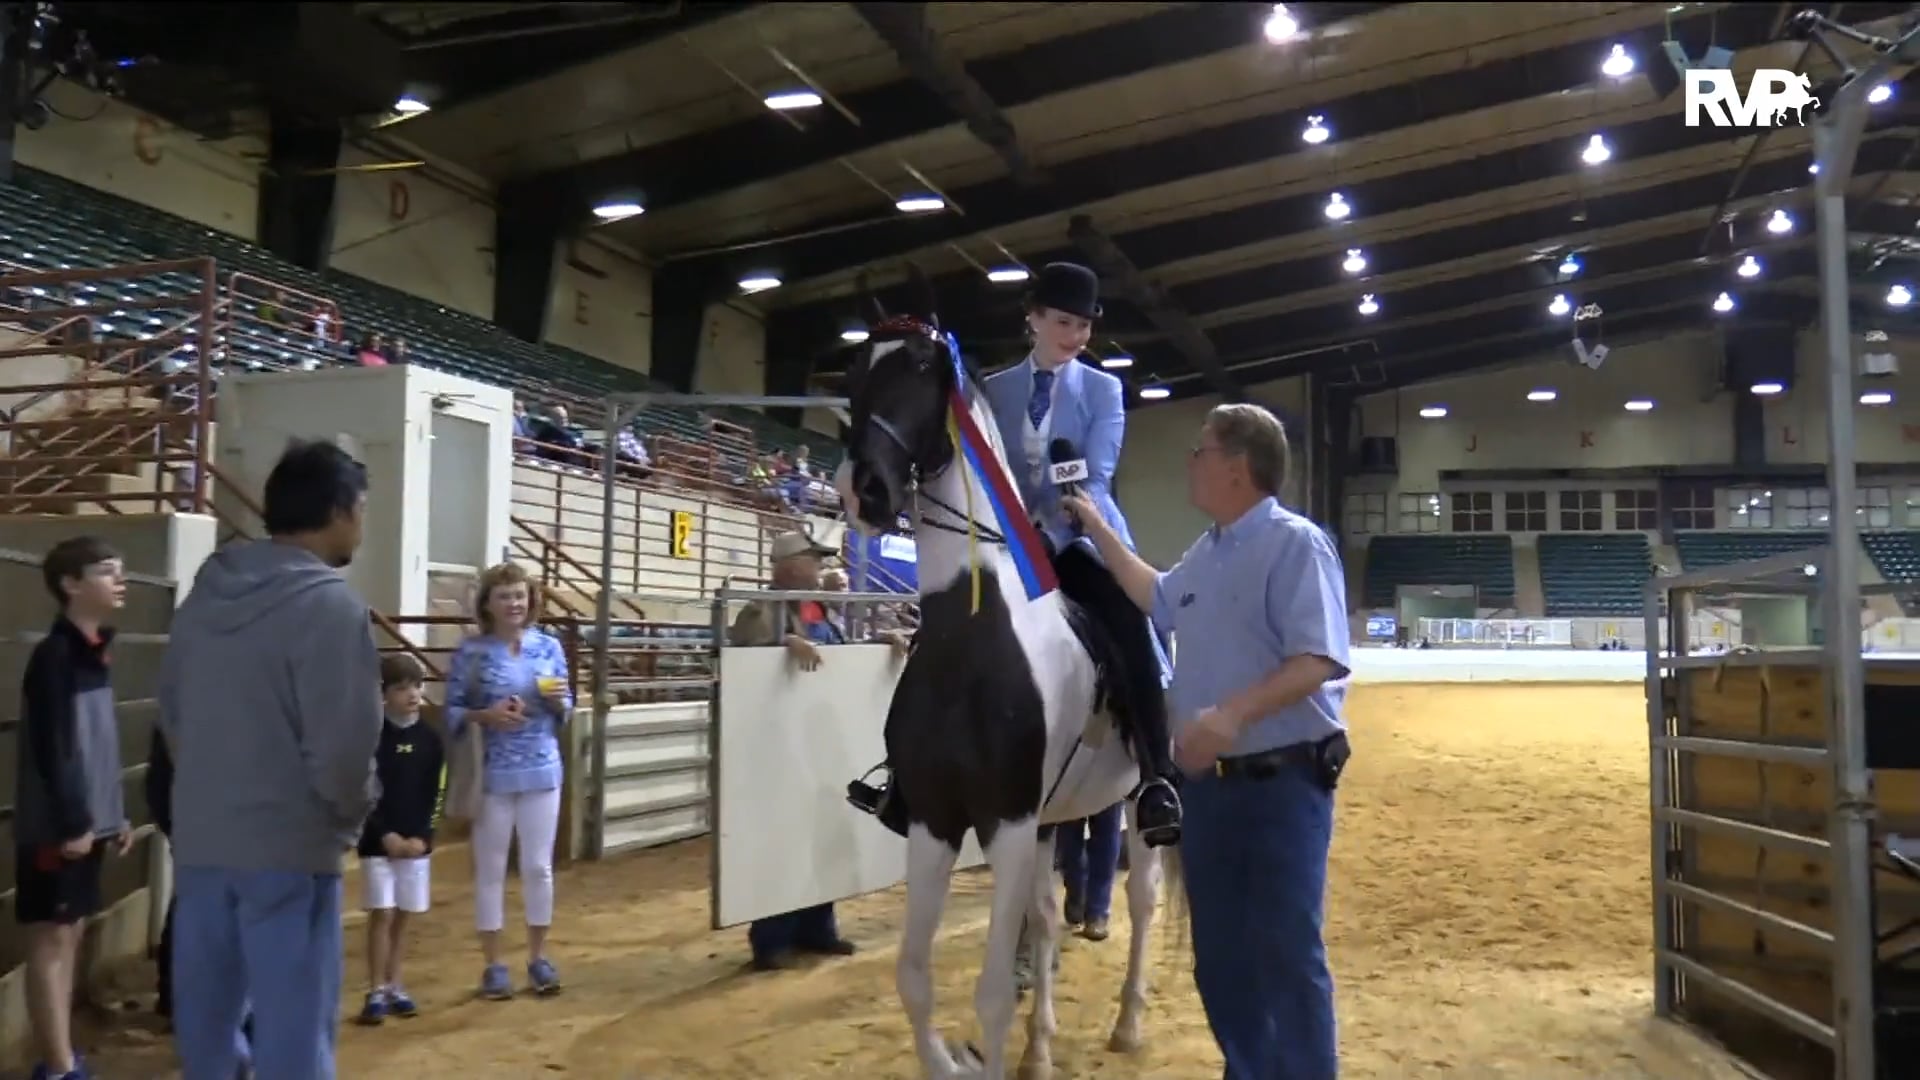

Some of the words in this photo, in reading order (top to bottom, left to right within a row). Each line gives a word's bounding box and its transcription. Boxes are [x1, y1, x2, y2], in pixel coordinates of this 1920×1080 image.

[389, 180, 409, 221] D
[575, 290, 590, 326] E
[1579, 430, 1595, 448] K
[1055, 463, 1080, 480] RVP
